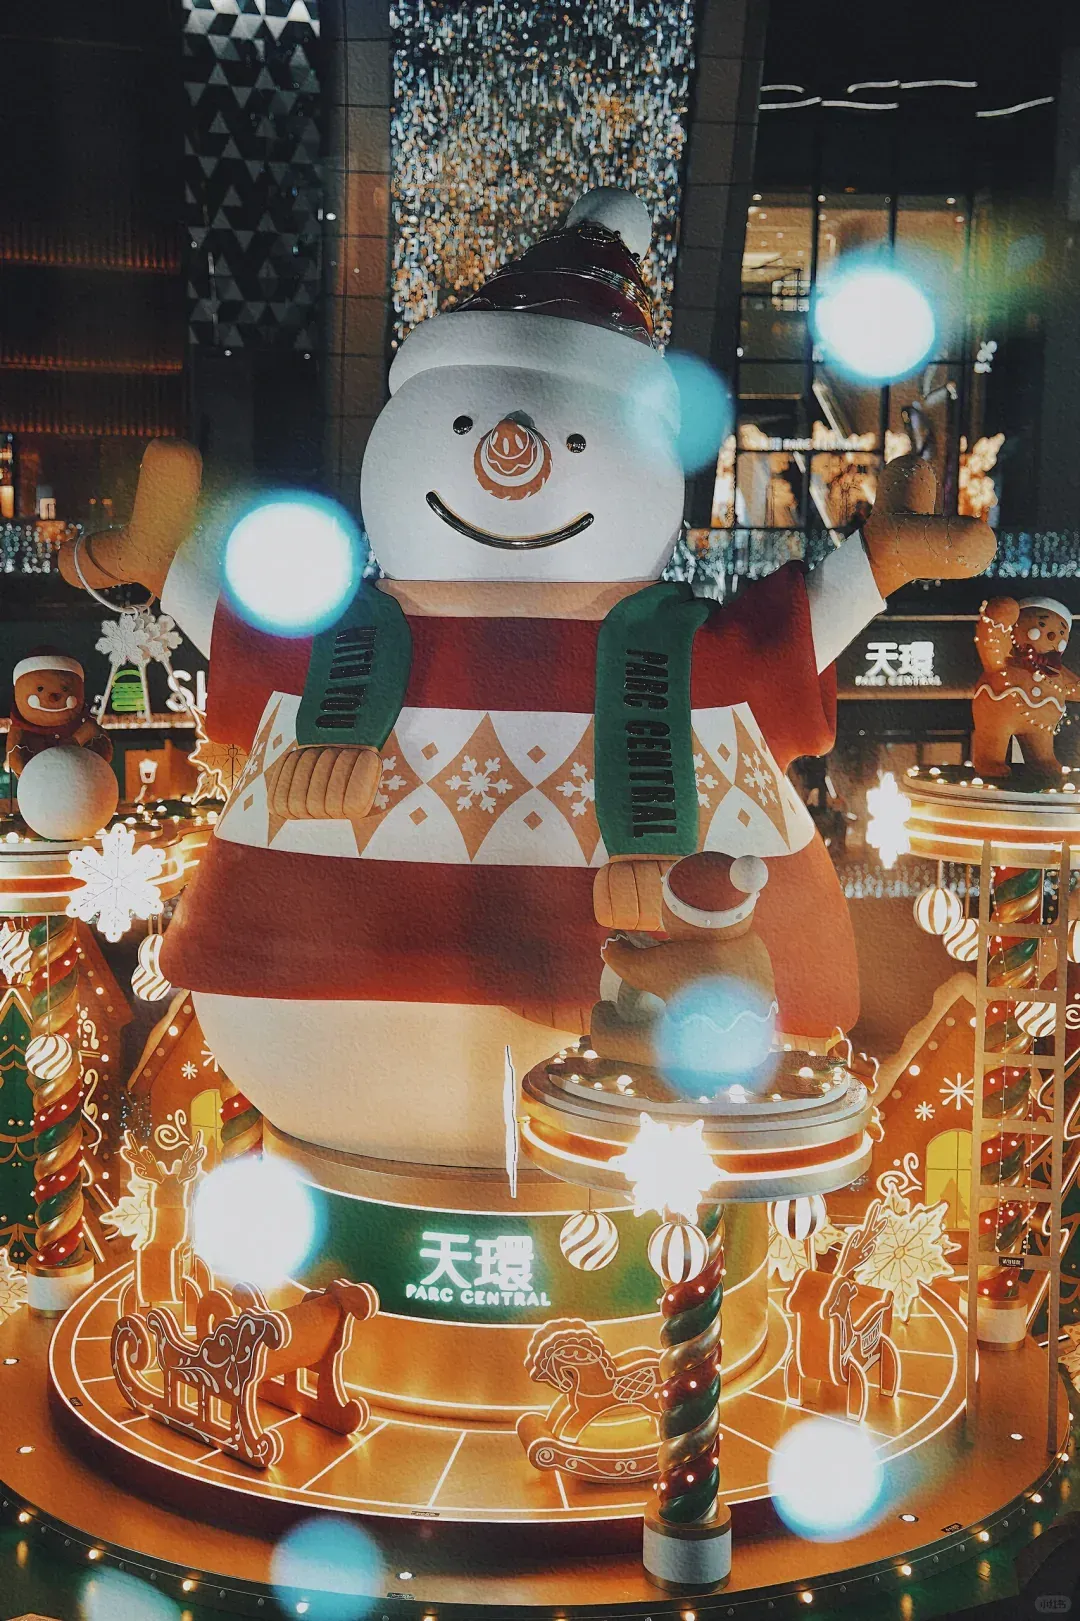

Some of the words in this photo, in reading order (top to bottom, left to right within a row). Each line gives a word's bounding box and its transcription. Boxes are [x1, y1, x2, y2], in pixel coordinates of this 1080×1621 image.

[624, 649, 668, 710] PARC
[625, 719, 677, 838] CENTRAL
[419, 1231, 535, 1292] 天環
[405, 1283, 454, 1303] PARC
[460, 1289, 551, 1307] CENTRAL
